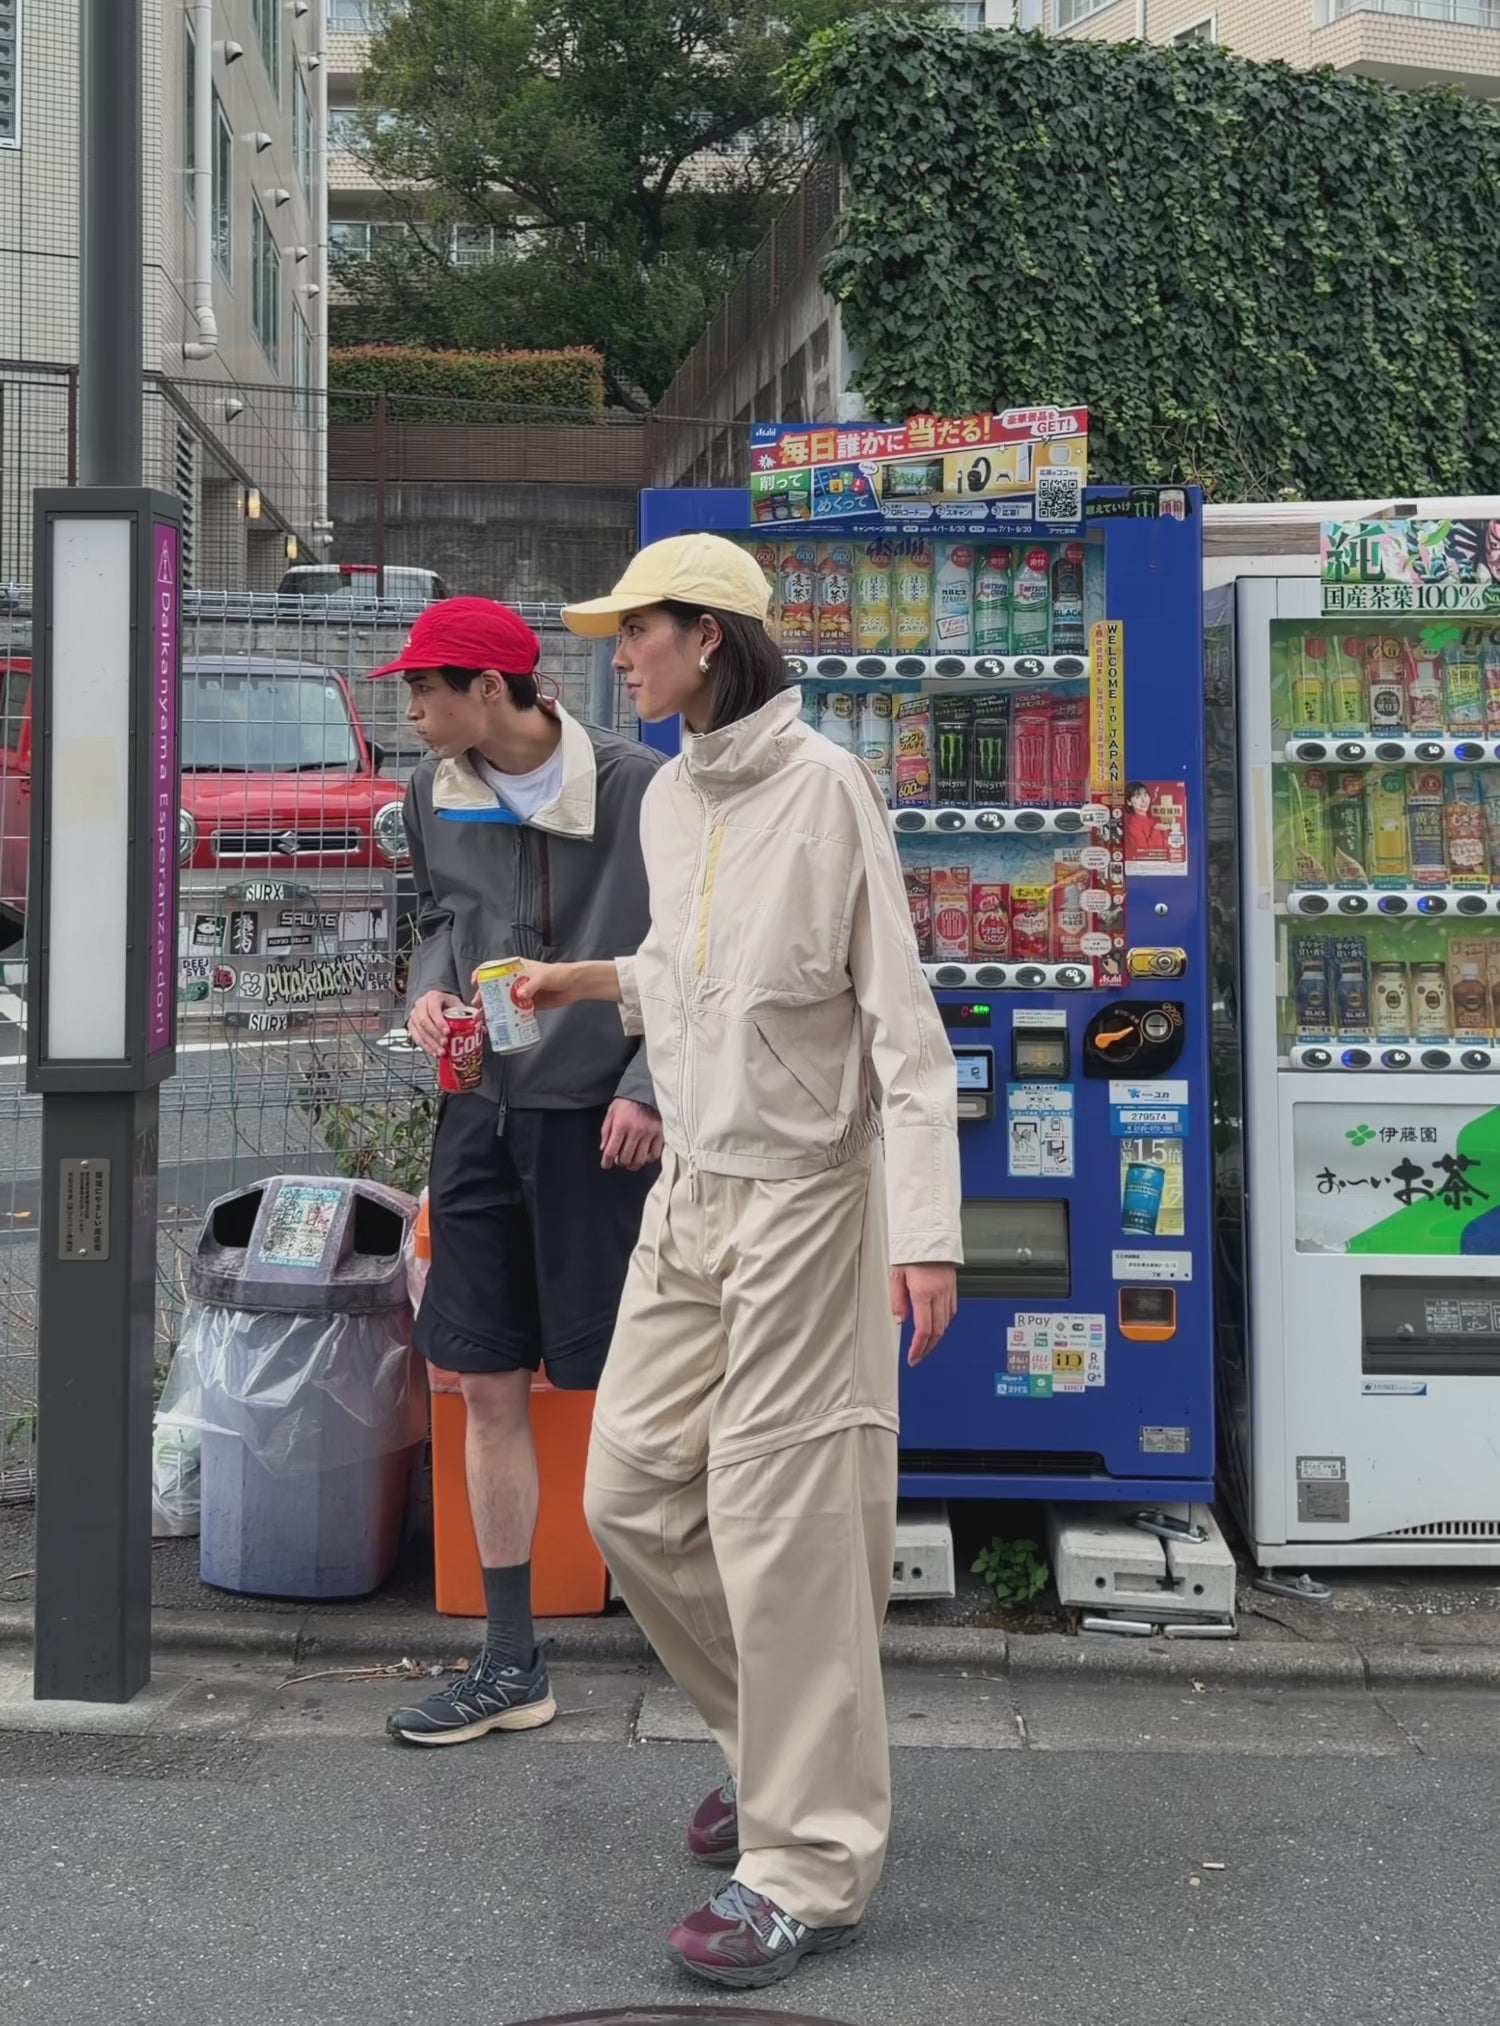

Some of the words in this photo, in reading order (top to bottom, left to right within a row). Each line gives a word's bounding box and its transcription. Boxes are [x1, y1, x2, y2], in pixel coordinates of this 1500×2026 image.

[755, 428, 776, 436] Asahi
[1037, 420, 1071, 433] GET!
[759, 473, 803, 491] 削って
[816, 495, 869, 512] めくって
[1327, 523, 1385, 582] 純
[1107, 624, 1118, 699] WELCOME
[158, 592, 170, 779] Daikanyama
[1109, 705, 1117, 722] TO
[1108, 728, 1119, 782] JAPAN
[156, 793, 168, 1034] Esperanza-dori
[281, 911, 337, 927] SAUTE
[1099, 973, 1122, 983] Asahi
[1131, 1112, 1167, 1121] 279574
[1379, 1126, 1437, 1143] 伊藤園
[1028, 1315, 1050, 1327] Pay
[1056, 1353, 1082, 1366] iD
